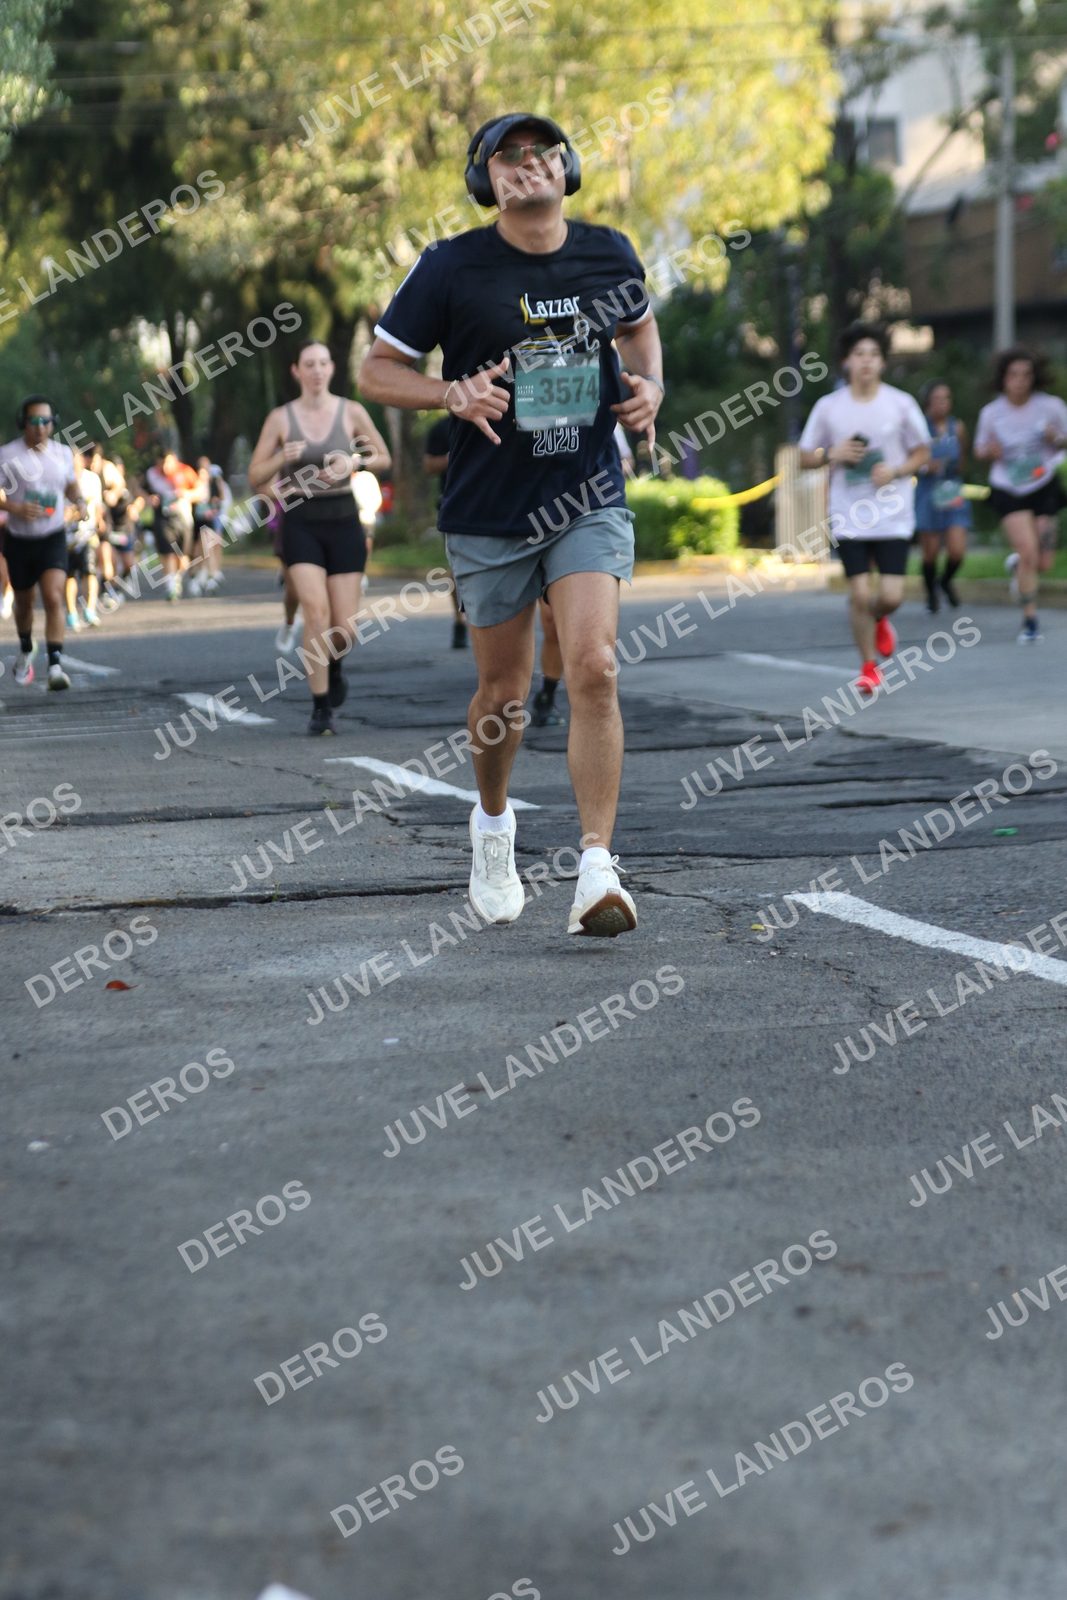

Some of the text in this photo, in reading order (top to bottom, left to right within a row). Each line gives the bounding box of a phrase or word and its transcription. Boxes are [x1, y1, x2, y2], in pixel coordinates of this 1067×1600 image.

[525, 292, 580, 319] Lazzar
[539, 374, 597, 406] 3574
[532, 426, 579, 457] 2026
